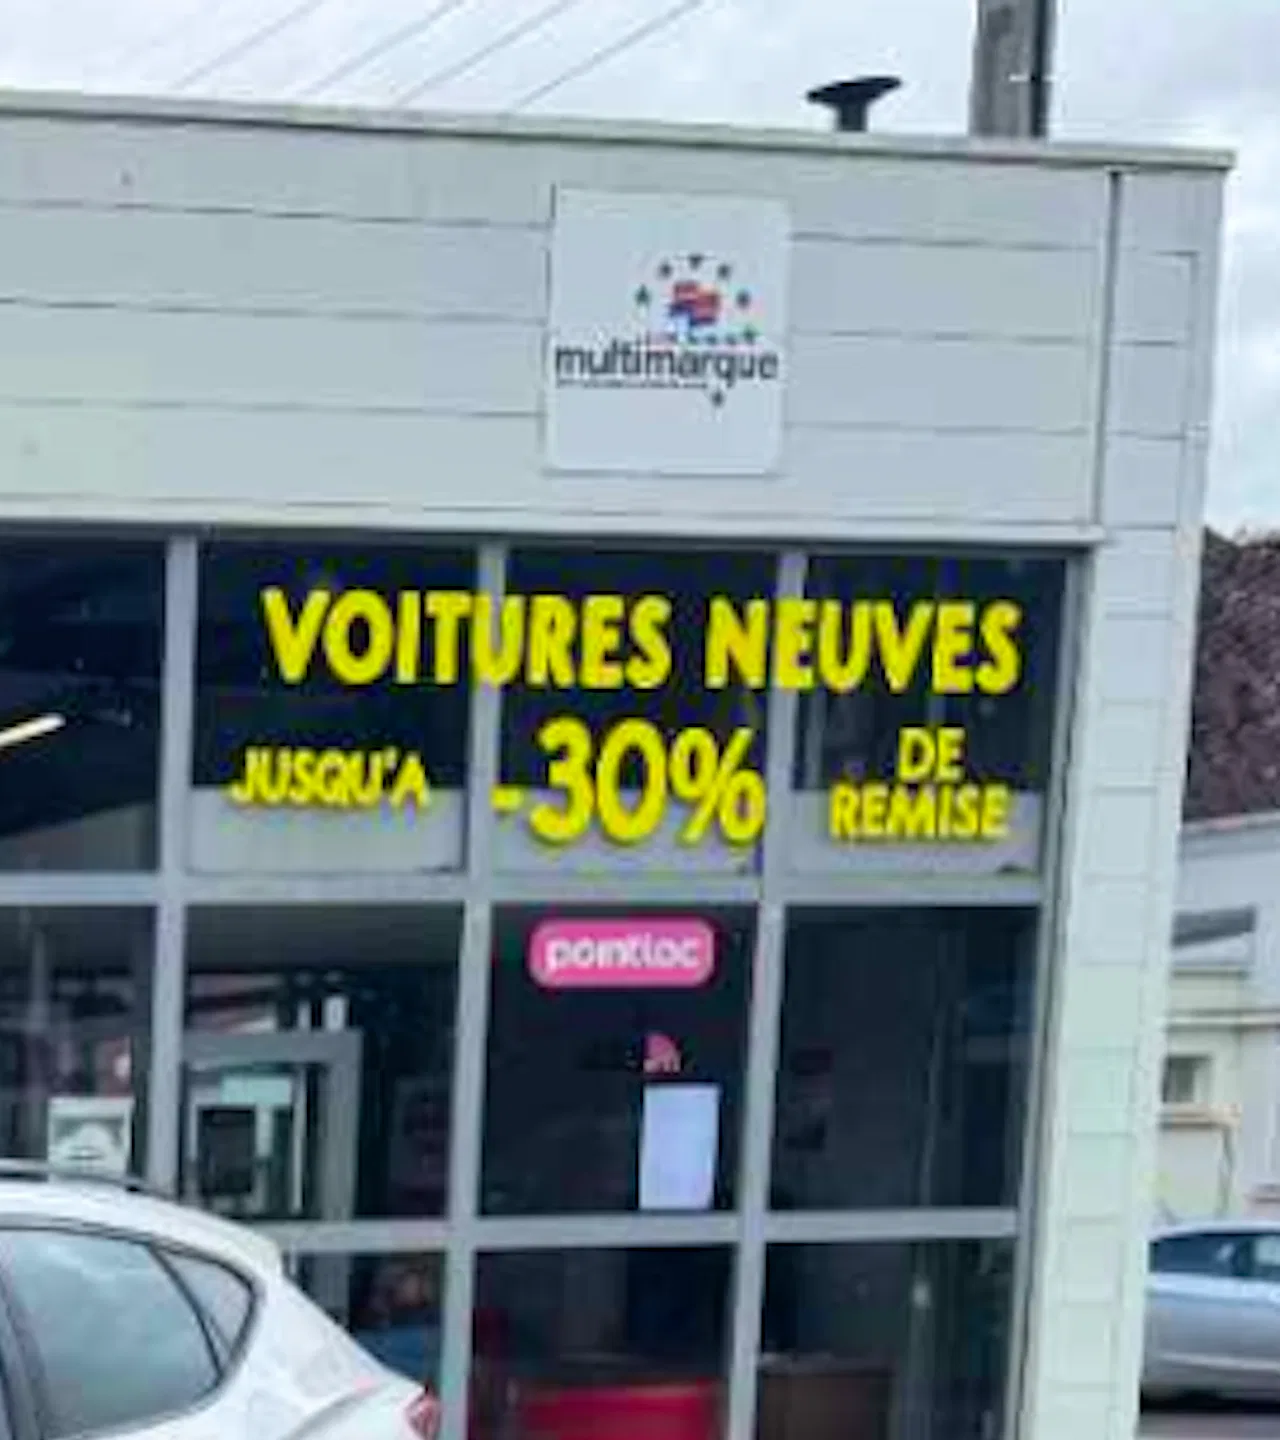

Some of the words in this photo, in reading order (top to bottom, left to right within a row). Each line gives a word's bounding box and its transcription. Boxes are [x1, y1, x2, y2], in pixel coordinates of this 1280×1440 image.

[555, 335, 780, 390] multimarque
[261, 587, 673, 690] VOITURES
[705, 597, 1023, 694] NEUVES
[490, 715, 767, 848] -30%
[898, 726, 965, 784] DE
[829, 782, 1011, 842] REMISE
